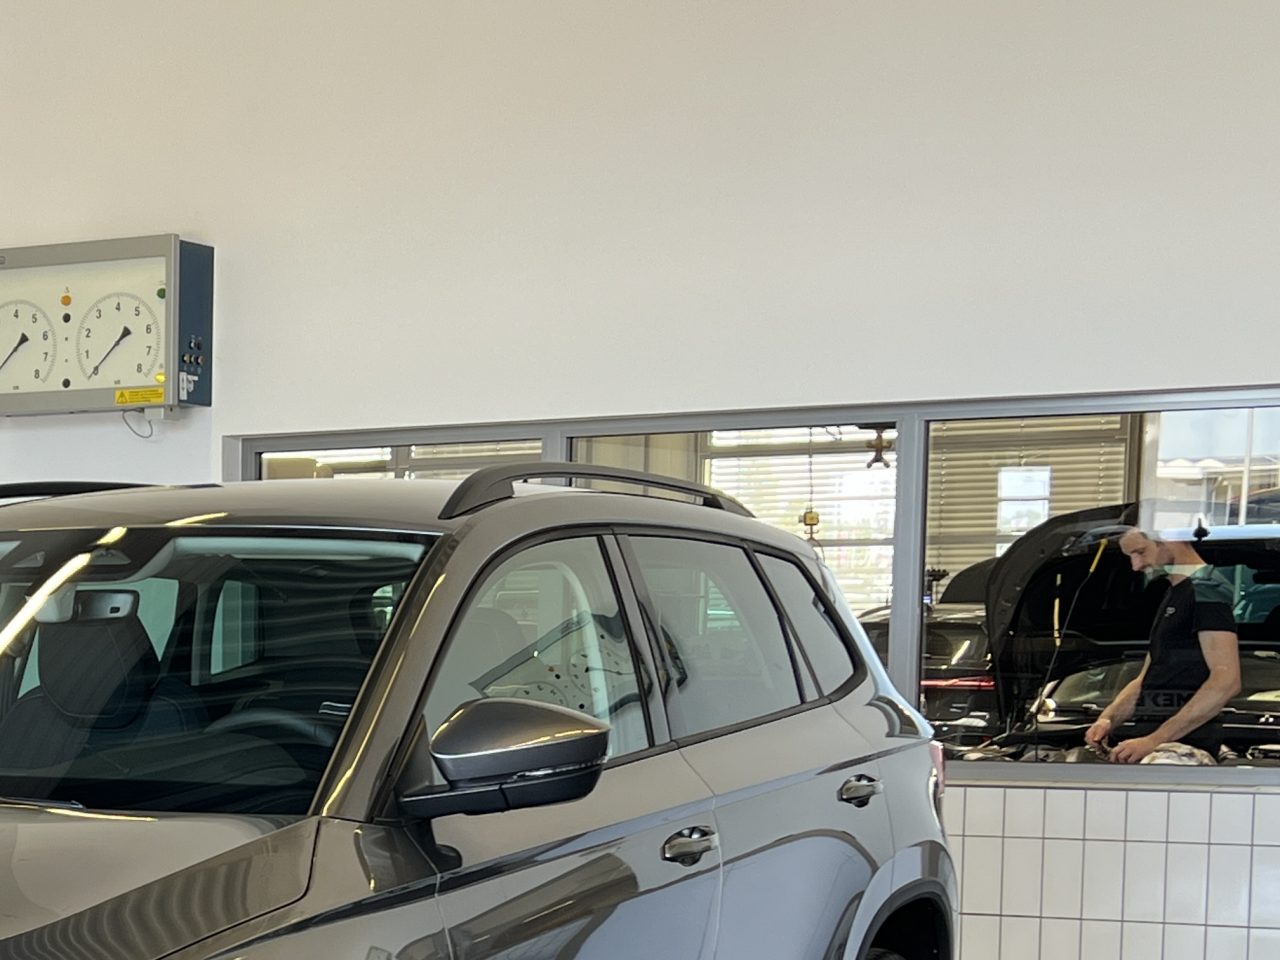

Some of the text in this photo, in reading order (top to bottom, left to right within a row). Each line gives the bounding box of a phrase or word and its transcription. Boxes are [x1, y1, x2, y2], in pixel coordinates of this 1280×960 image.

[115, 301, 121, 312] 4
[134, 306, 140, 317] 5
[13, 308, 19, 319] 4
[31, 313, 38, 324] 5
[95, 308, 102, 319] 3
[85, 328, 91, 338] 2
[145, 323, 152, 334] 6
[42, 330, 49, 341] 6
[84, 349, 89, 359] 1
[145, 345, 152, 356] 7
[42, 351, 49, 362] 7
[136, 362, 143, 373] 8
[34, 368, 40, 379] 8
